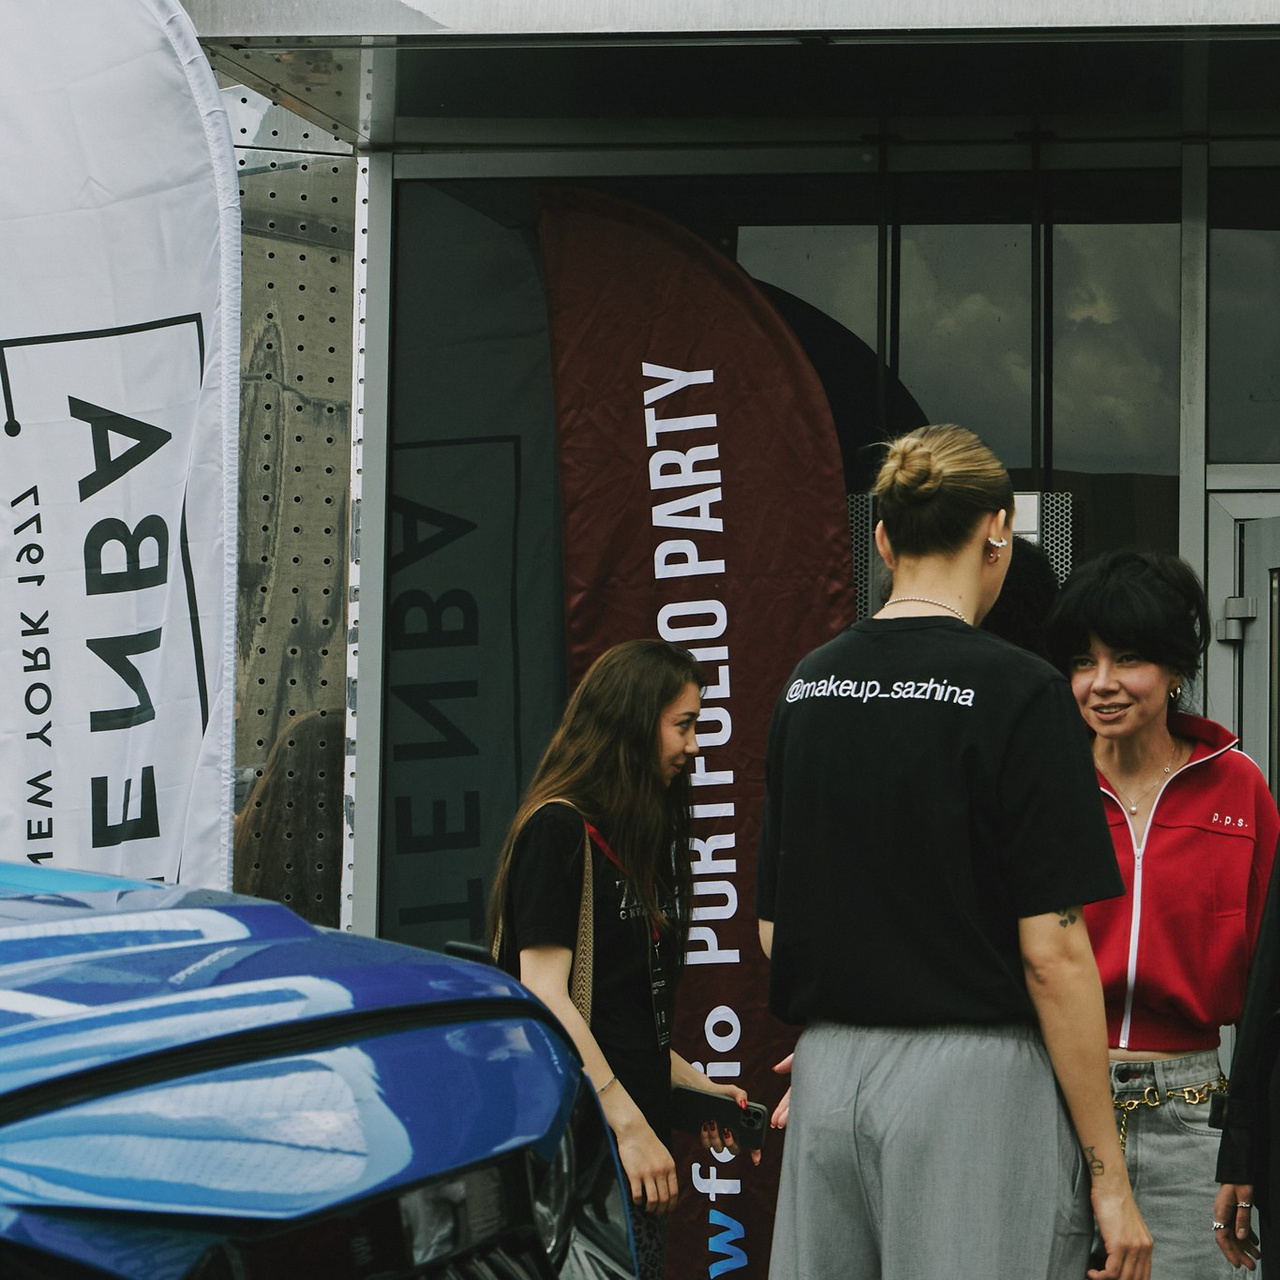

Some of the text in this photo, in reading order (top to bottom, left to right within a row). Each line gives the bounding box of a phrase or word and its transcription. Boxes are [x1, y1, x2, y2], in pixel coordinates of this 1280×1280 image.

[642, 361, 725, 580] PARTY
[785, 674, 976, 707] @makeup_sazhina
[1211, 812, 1248, 827] p.p.s.
